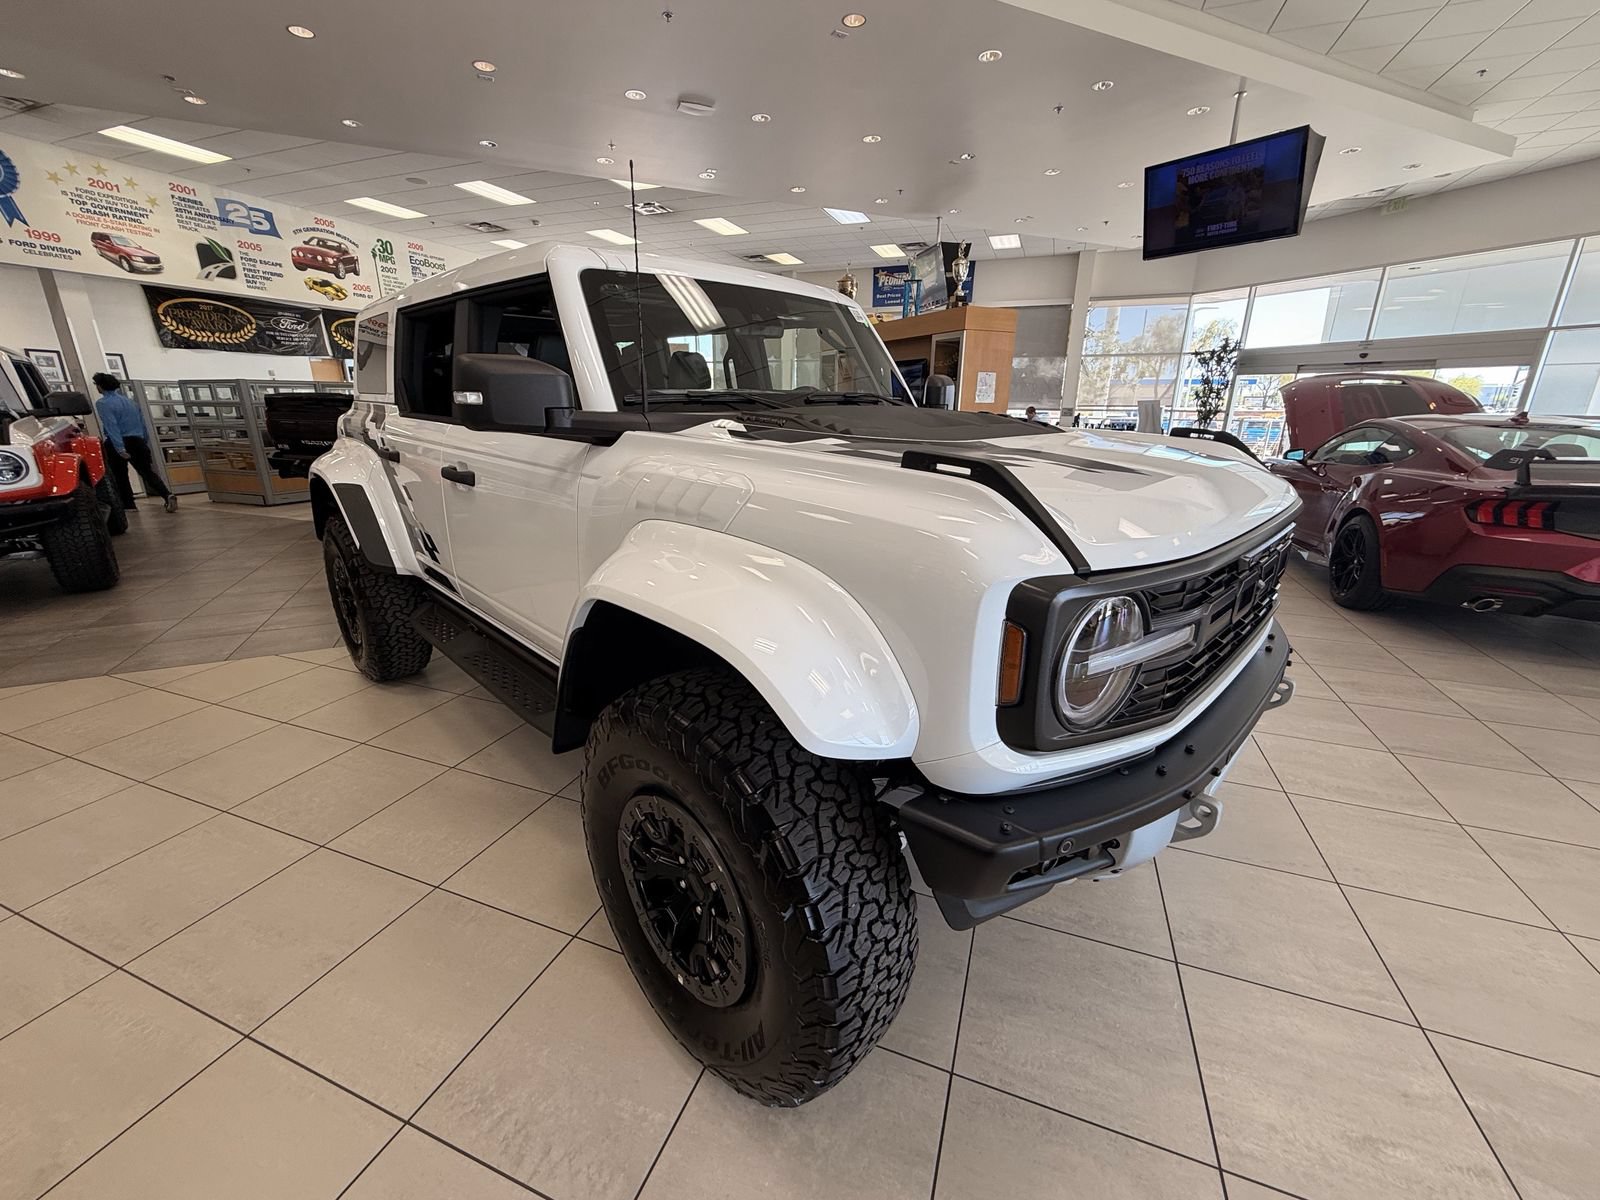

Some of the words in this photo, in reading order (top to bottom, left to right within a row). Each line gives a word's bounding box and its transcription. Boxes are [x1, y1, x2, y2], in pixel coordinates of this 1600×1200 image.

[1188, 173, 1208, 184] MORE
[87, 178, 120, 193] 2001
[168, 182, 197, 196] 2001
[69, 192, 84, 200] THE
[85, 196, 102, 204] ONLY
[130, 204, 148, 213] EARN
[75, 187, 96, 196] FORD
[97, 191, 138, 206] EXPEDITION
[170, 194, 204, 206] F-SERIES
[68, 198, 88, 206] TOP
[91, 202, 150, 220] GOVERNMENT
[172, 201, 210, 213] CELEBRATES
[174, 206, 192, 216] 25TH
[72, 212, 101, 223] DOUBLE
[102, 218, 127, 227] 5-STAR
[129, 222, 152, 232] RATING
[80, 207, 110, 218] CRASH
[112, 212, 145, 225] RATING.
[185, 215, 216, 226] AMERICA'S
[225, 202, 271, 231] 25
[314, 216, 336, 228] 2005
[76, 218, 100, 228] FRONT
[101, 222, 124, 232] CRASH
[176, 218, 192, 226] BEST
[193, 222, 218, 232] SELLING
[24, 228, 62, 243] 1999
[292, 228, 302, 236] 5TH
[302, 226, 335, 236] GENERATION
[336, 232, 360, 248] MUSTANG
[8, 239, 37, 249] FORD
[40, 244, 82, 256] DIVISION
[237, 240, 262, 252] 2005
[376, 238, 394, 256] 30
[22, 248, 73, 260] CELEBRATES
[378, 254, 396, 265] MPG
[240, 256, 258, 264] FORD
[259, 260, 282, 268] ESCAPE
[409, 255, 446, 271] EcoBoost
[262, 270, 284, 278] HYBRID
[380, 266, 397, 274] 2007
[244, 273, 272, 282] ELECTRIC
[352, 283, 372, 292] 2005
[190, 320, 233, 331] AWARD
[280, 318, 305, 330] Ford
